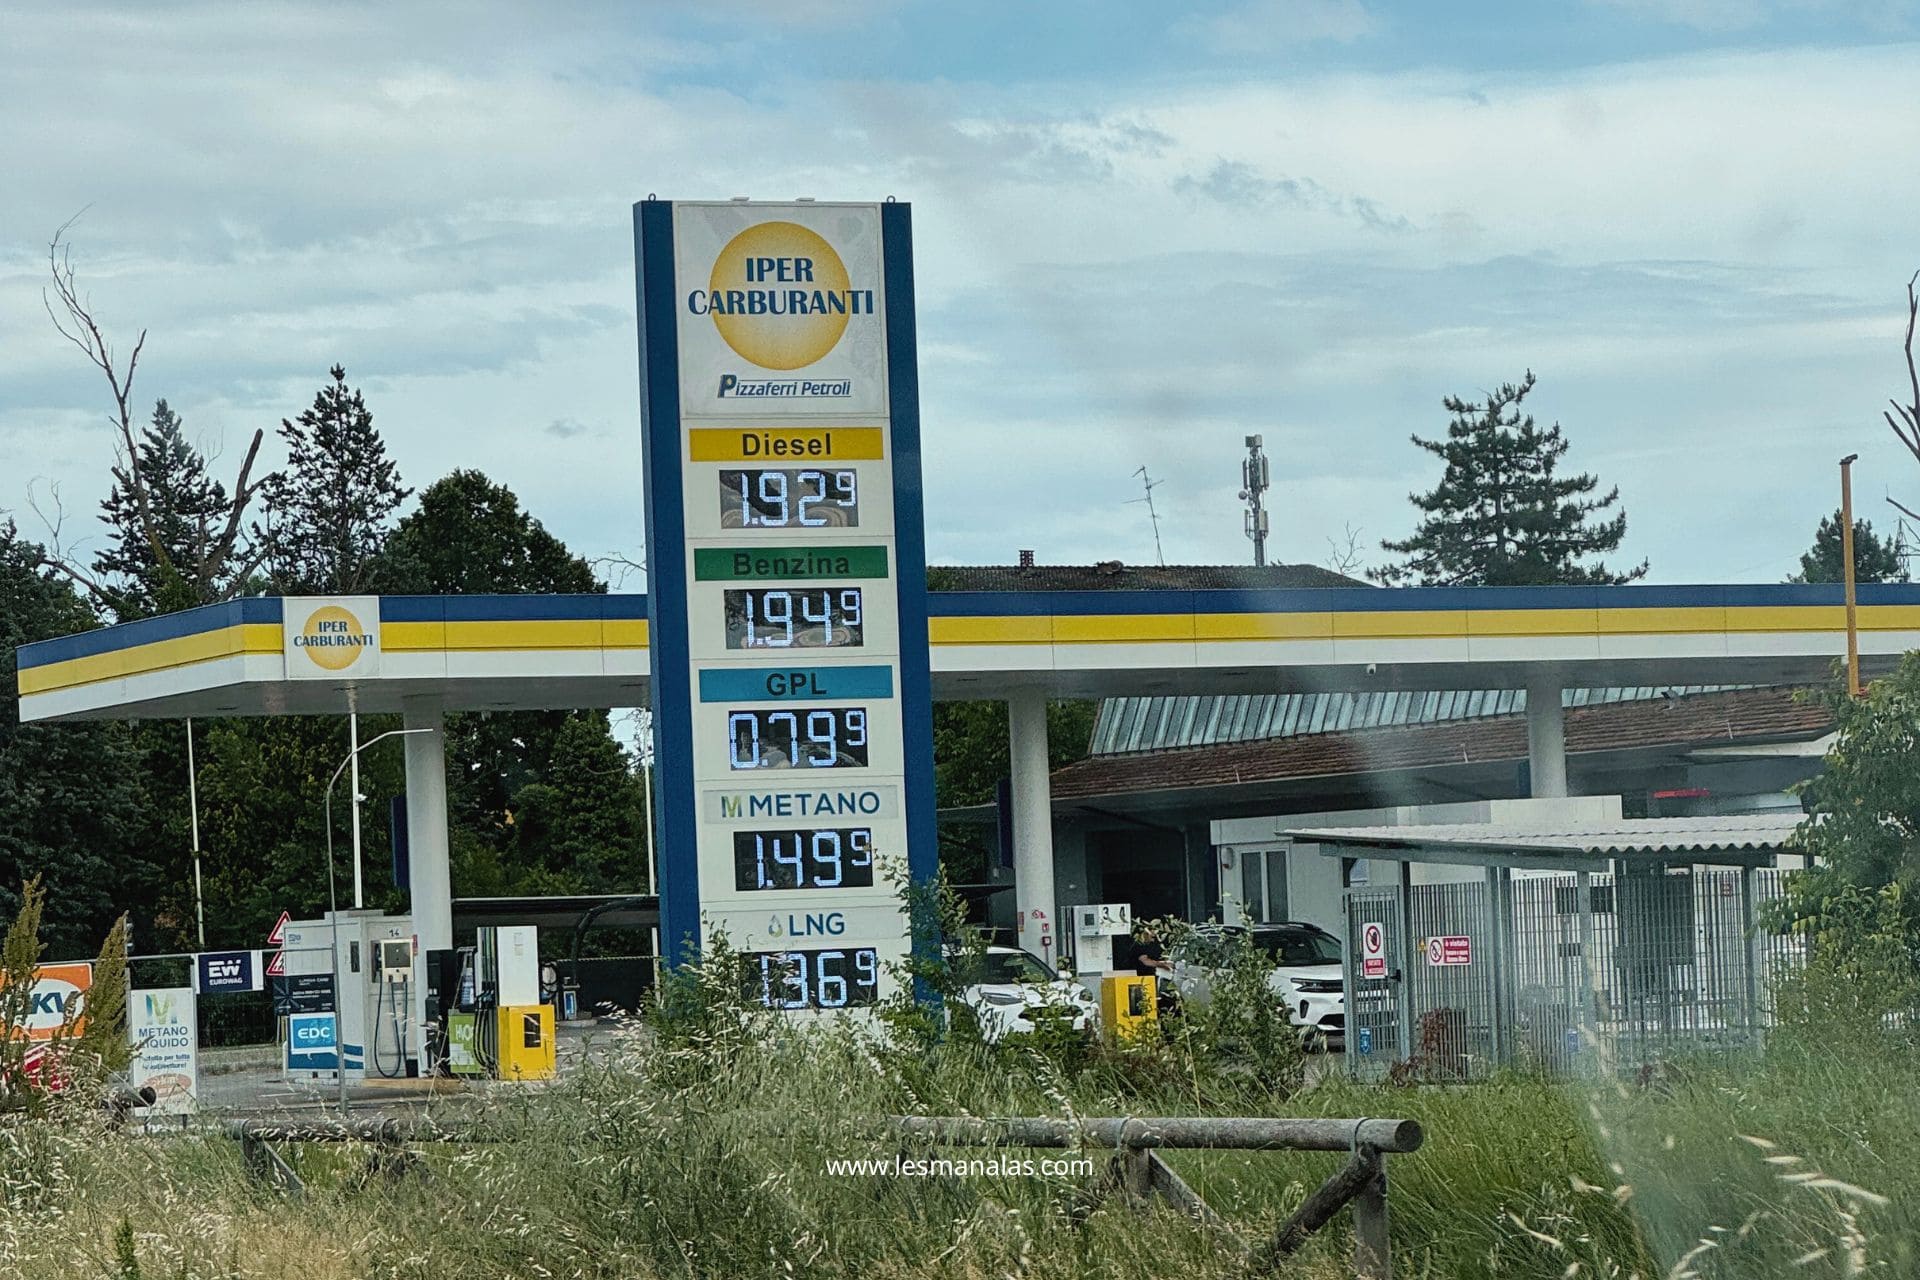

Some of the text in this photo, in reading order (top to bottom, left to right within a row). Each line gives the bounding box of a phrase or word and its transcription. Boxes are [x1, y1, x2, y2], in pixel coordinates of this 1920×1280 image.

[746, 257, 814, 283] IPER
[688, 289, 874, 315] CARBURANTI
[718, 374, 851, 398] Pizzaferri Petroli
[742, 432, 832, 456] Diesel
[733, 551, 850, 576] Benzina
[319, 621, 348, 632] IPER
[293, 634, 374, 647] CARBURANTI
[766, 672, 827, 696] GPL
[750, 791, 880, 817] METANO
[789, 912, 845, 937] LNG
[208, 959, 242, 978] EW
[209, 977, 243, 986] EUROWAG
[138, 1026, 188, 1037] METANO
[297, 1027, 331, 1039] EDC
